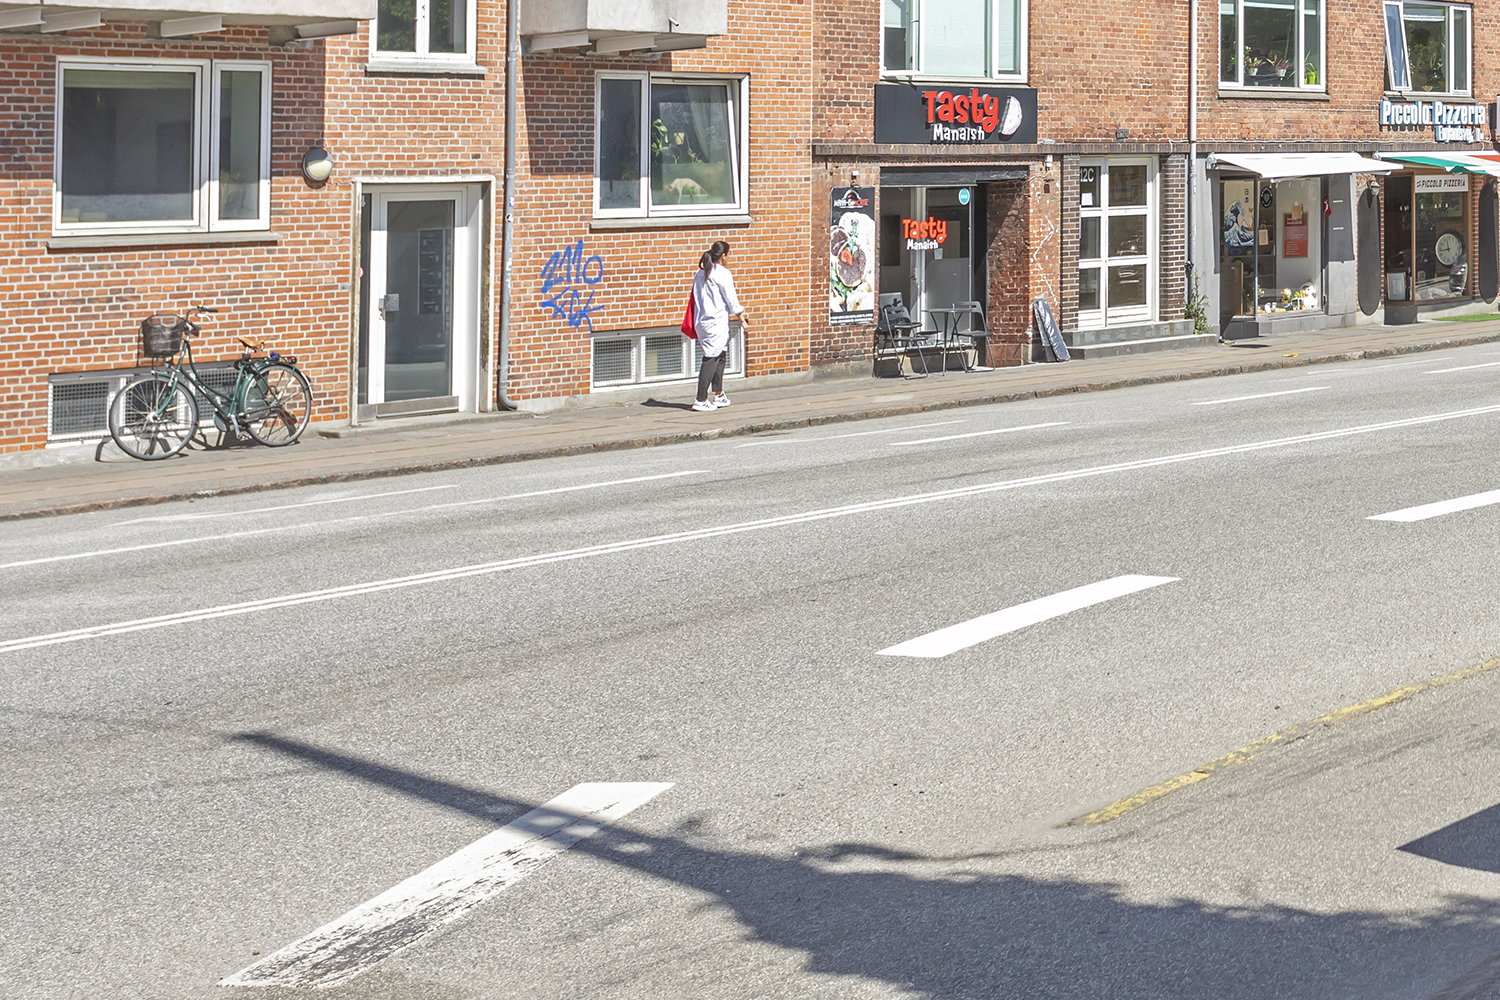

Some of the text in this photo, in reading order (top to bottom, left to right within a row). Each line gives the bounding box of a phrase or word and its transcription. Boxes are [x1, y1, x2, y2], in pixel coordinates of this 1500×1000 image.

[923, 88, 1000, 133] Tasty
[1380, 101, 1486, 125] Piccolo Pizzeria
[932, 124, 985, 141] Manaish
[1421, 179, 1466, 188] PICCOLO PIZZERIA
[902, 216, 948, 243] Tasty
[906, 238, 939, 251] Manaish
